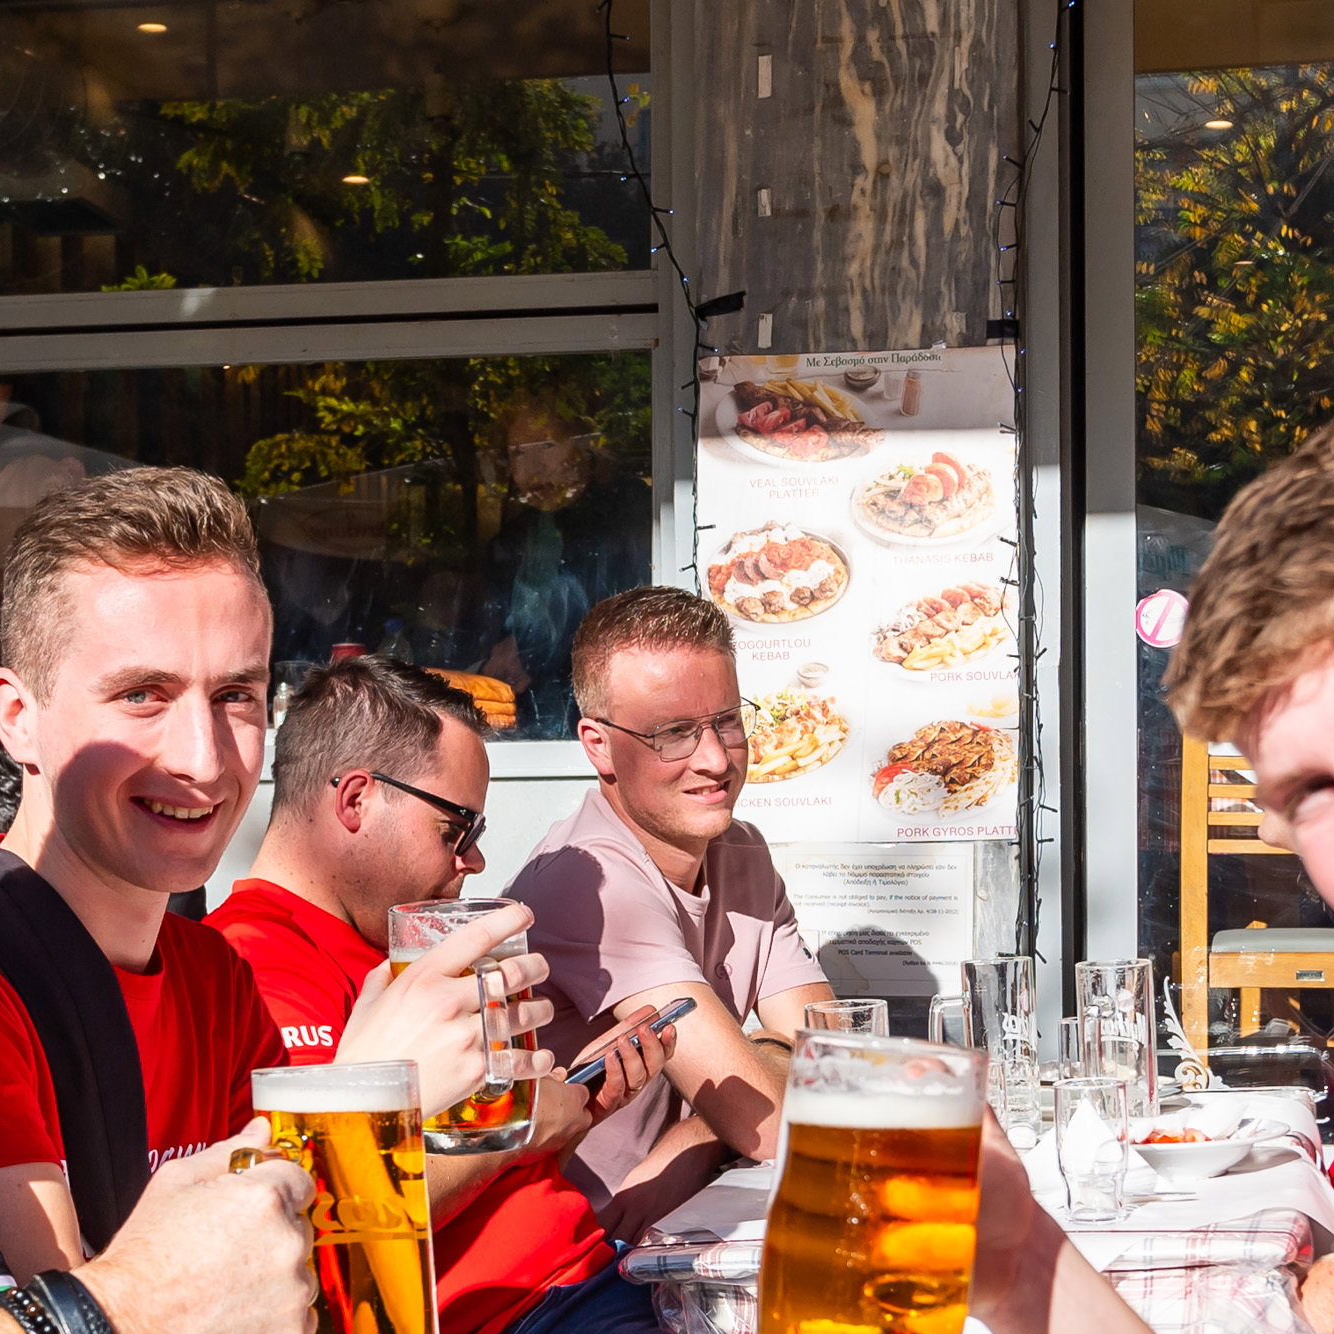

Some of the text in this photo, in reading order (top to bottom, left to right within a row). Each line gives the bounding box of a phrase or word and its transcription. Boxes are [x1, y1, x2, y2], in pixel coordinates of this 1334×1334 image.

[805, 357, 822, 367] Με
[823, 356, 865, 369] Σεβασμό
[749, 478, 777, 489] VEAL
[953, 552, 994, 563] KEBAB
[752, 651, 790, 661] KEBAB
[930, 672, 962, 682] PORK
[735, 796, 832, 809] ICKEN SOUVLAKI
[897, 827, 928, 838] PORK
[932, 826, 974, 837] GYROS
